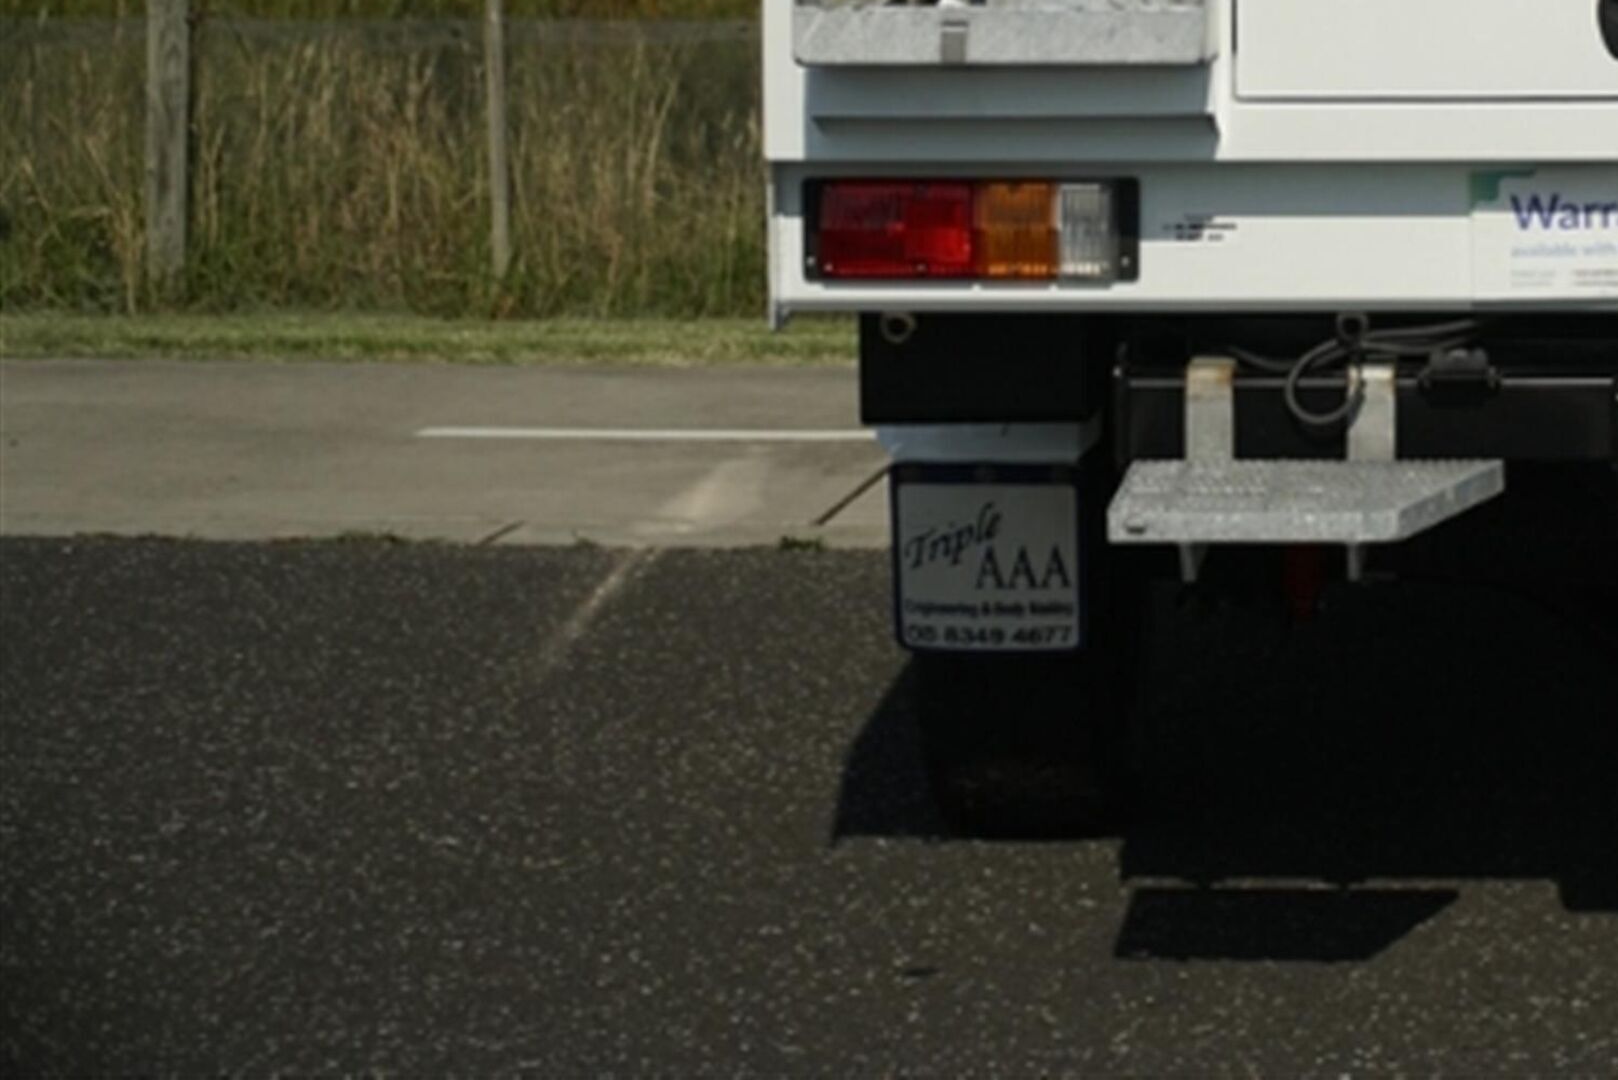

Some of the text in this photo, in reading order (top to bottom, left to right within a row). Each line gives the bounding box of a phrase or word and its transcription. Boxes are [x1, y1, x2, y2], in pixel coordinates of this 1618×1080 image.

[904, 500, 1071, 590] Triple AAA
[1011, 624, 1073, 643] 4677
